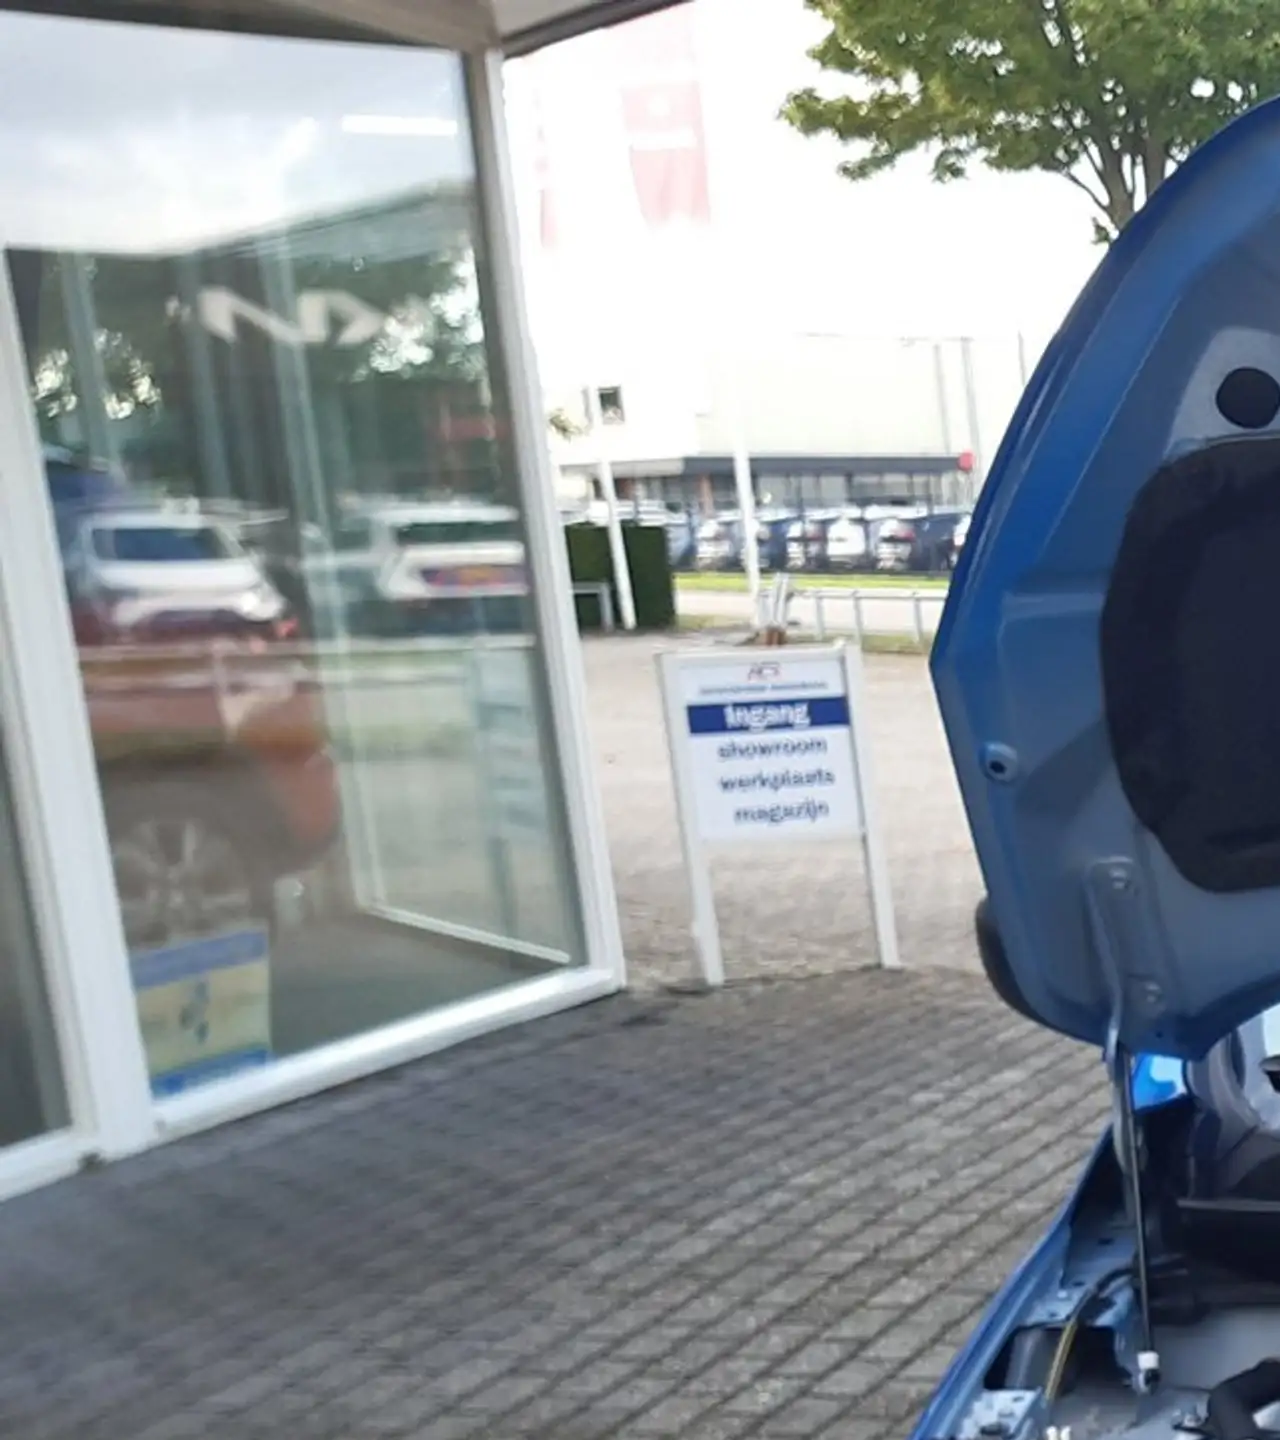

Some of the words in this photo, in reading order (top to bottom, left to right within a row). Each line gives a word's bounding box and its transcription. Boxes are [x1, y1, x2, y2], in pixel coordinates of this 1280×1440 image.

[723, 702, 811, 732] Ingang
[718, 740, 827, 760] showroom
[719, 769, 836, 793] werkplaats
[735, 800, 829, 825] magazijn
